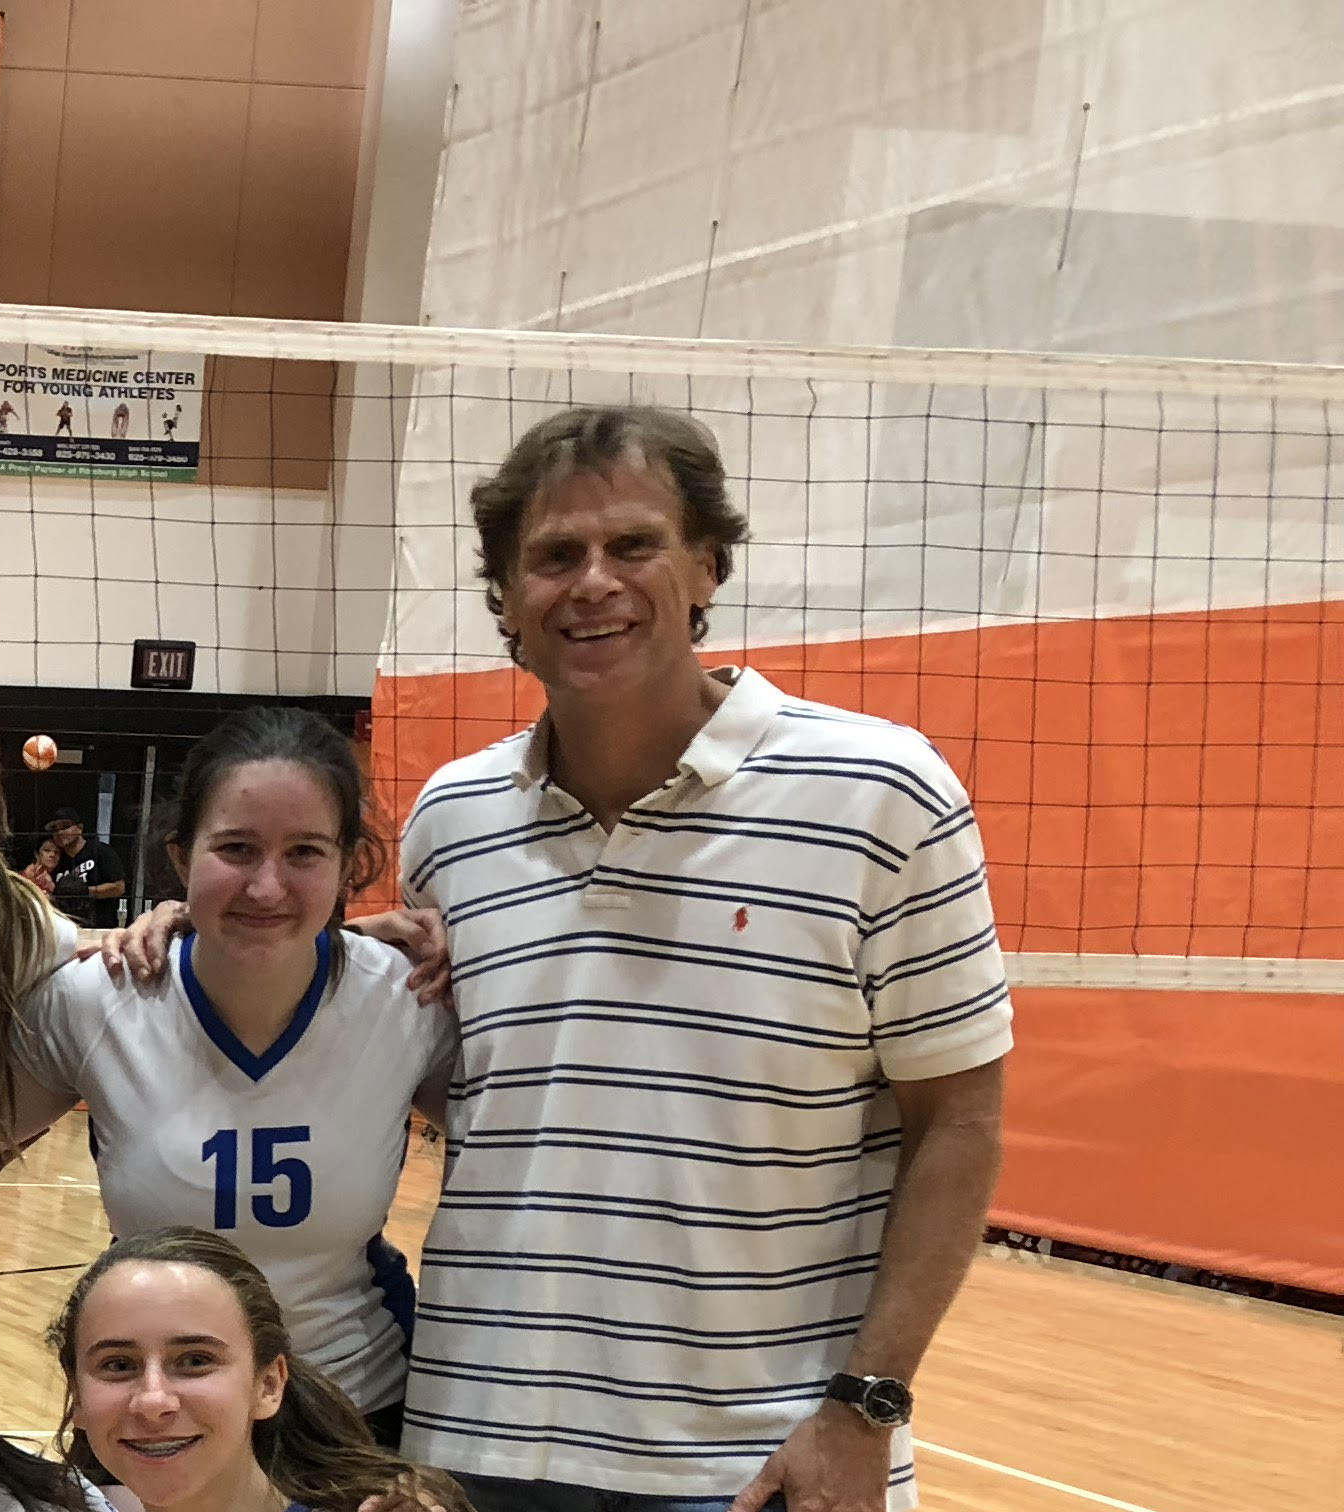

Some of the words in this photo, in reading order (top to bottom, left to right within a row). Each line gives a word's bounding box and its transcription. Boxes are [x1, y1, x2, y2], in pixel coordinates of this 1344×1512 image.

[52, 367, 129, 384] MEDICINE
[133, 371, 196, 386] CENTER
[3, 380, 36, 394] FOR
[41, 382, 94, 398] YOUNG
[98, 386, 176, 401] ATHLETES
[148, 651, 184, 677] EXIT
[202, 1126, 311, 1229] 15
